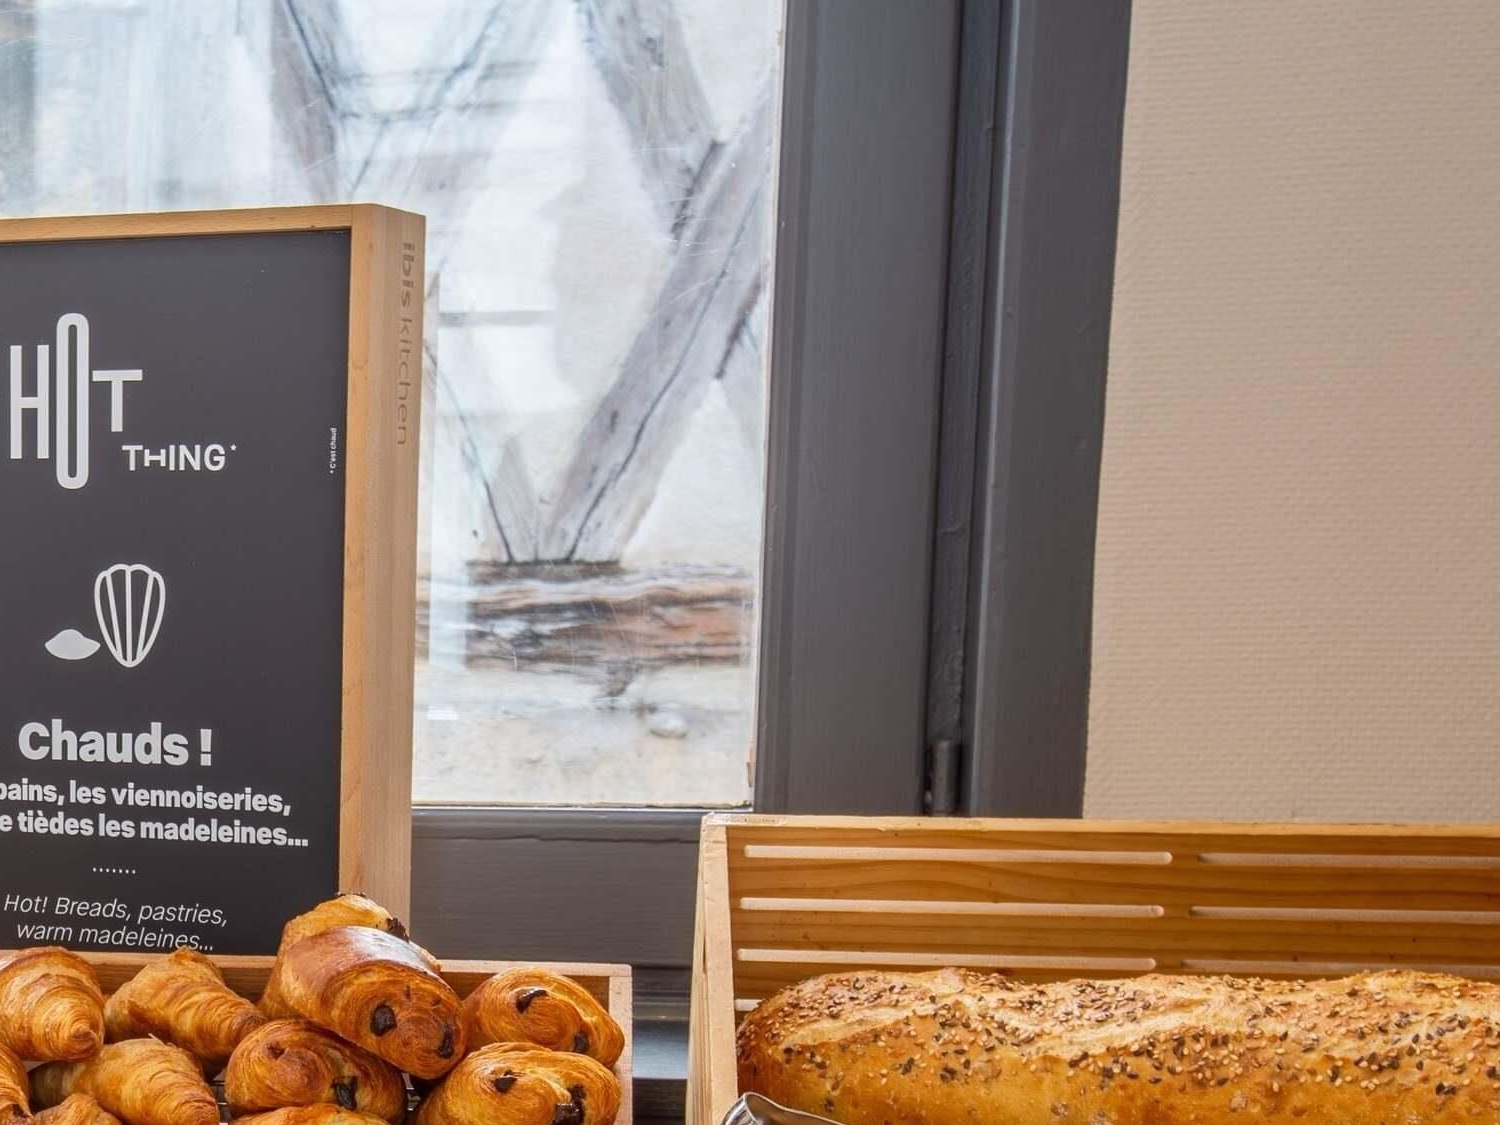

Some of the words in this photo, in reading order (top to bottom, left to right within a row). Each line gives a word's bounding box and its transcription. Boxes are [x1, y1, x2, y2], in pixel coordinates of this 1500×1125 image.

[401, 243, 416, 307] ibis
[10, 313, 143, 489] HOT
[397, 318, 412, 446] kitchen
[18, 718, 189, 766] Chauds
[69, 779, 107, 805] les
[111, 782, 291, 817] viennoiseries,
[17, 809, 94, 837] tièdes
[99, 813, 136, 838] les
[140, 818, 309, 847] madeleines...
[3, 894, 48, 914] Hot!
[55, 897, 131, 922] Breads,
[137, 902, 228, 928] pastries,
[17, 923, 73, 942] warm
[78, 924, 214, 952] madeleines...
